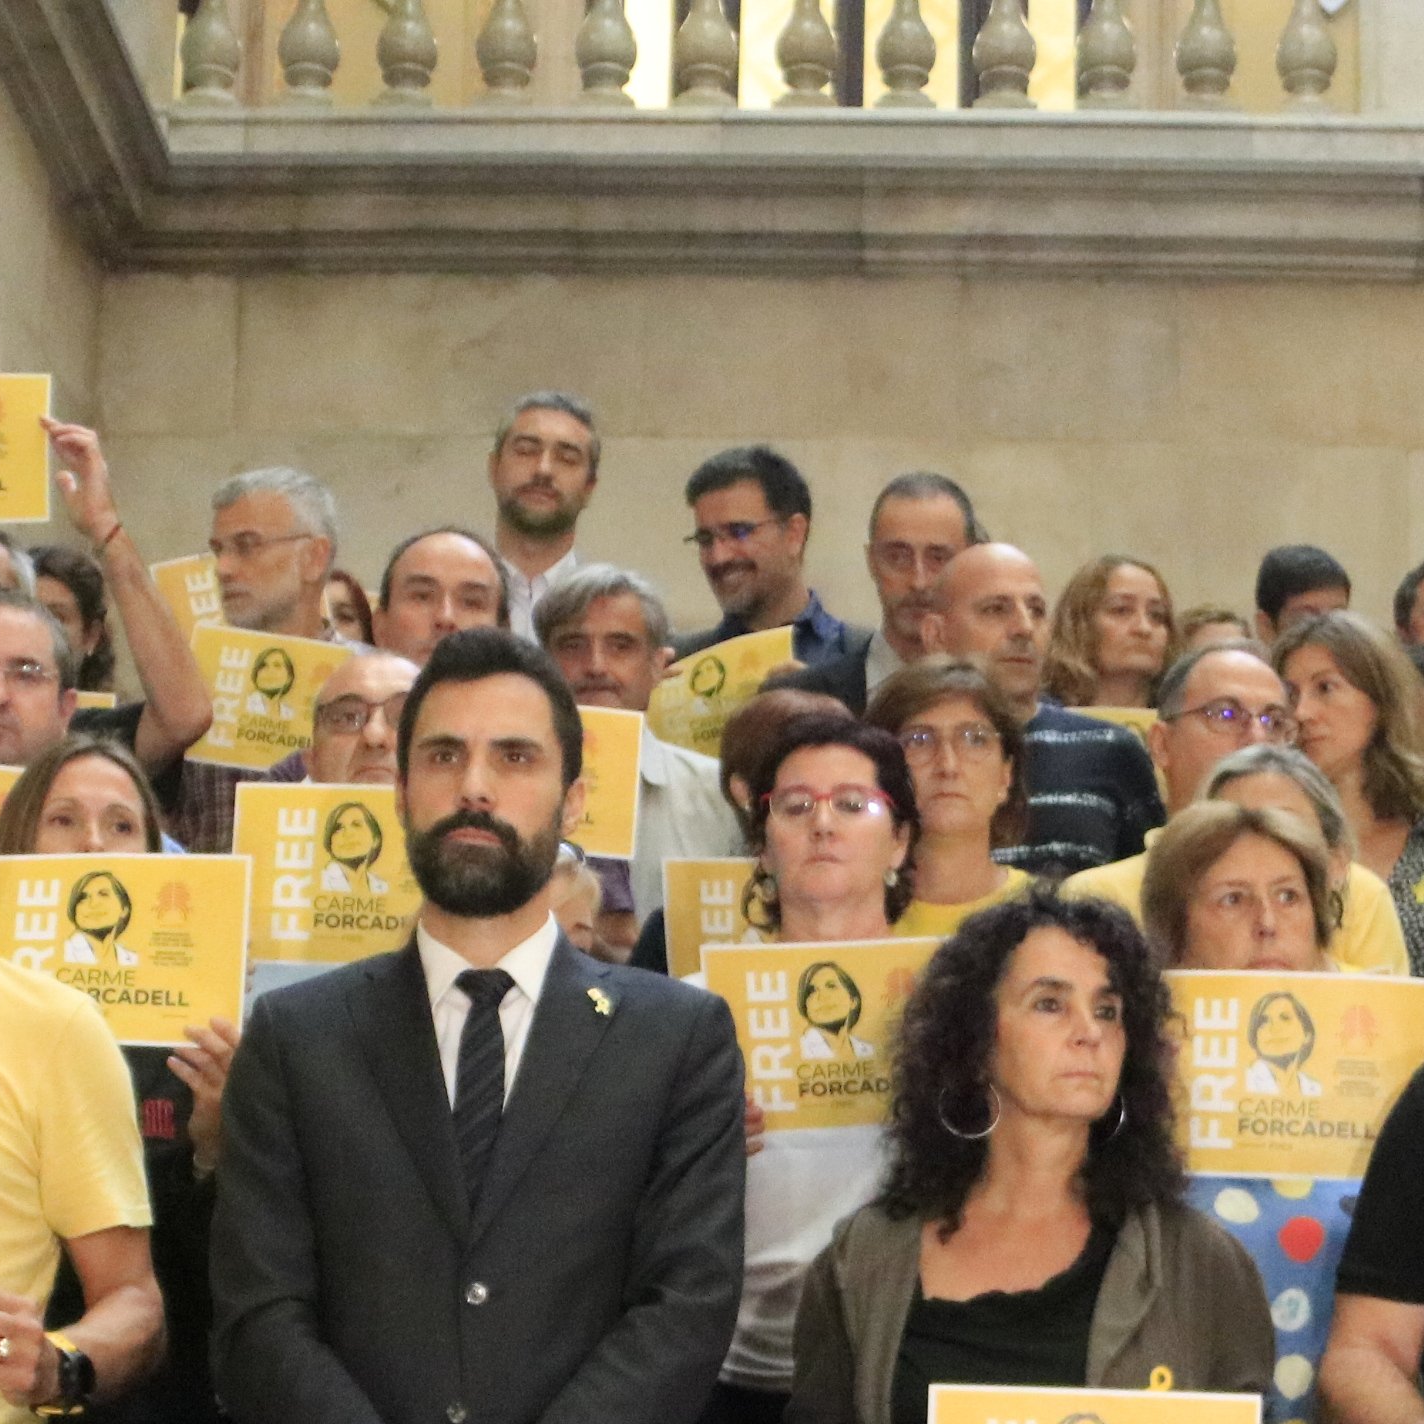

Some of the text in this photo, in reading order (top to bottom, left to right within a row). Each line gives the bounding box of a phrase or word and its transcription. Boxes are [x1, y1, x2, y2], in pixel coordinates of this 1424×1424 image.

[207, 646, 252, 748] FREE
[272, 808, 317, 940] FREE
[313, 895, 387, 914] CARME
[56, 967, 136, 987] CARME
[746, 971, 797, 1113] FREE
[796, 1062, 874, 1079] CARME
[1190, 997, 1240, 1149] FREE
[1238, 1098, 1320, 1117] CARME
[1238, 1118, 1378, 1140] FORCADELL
